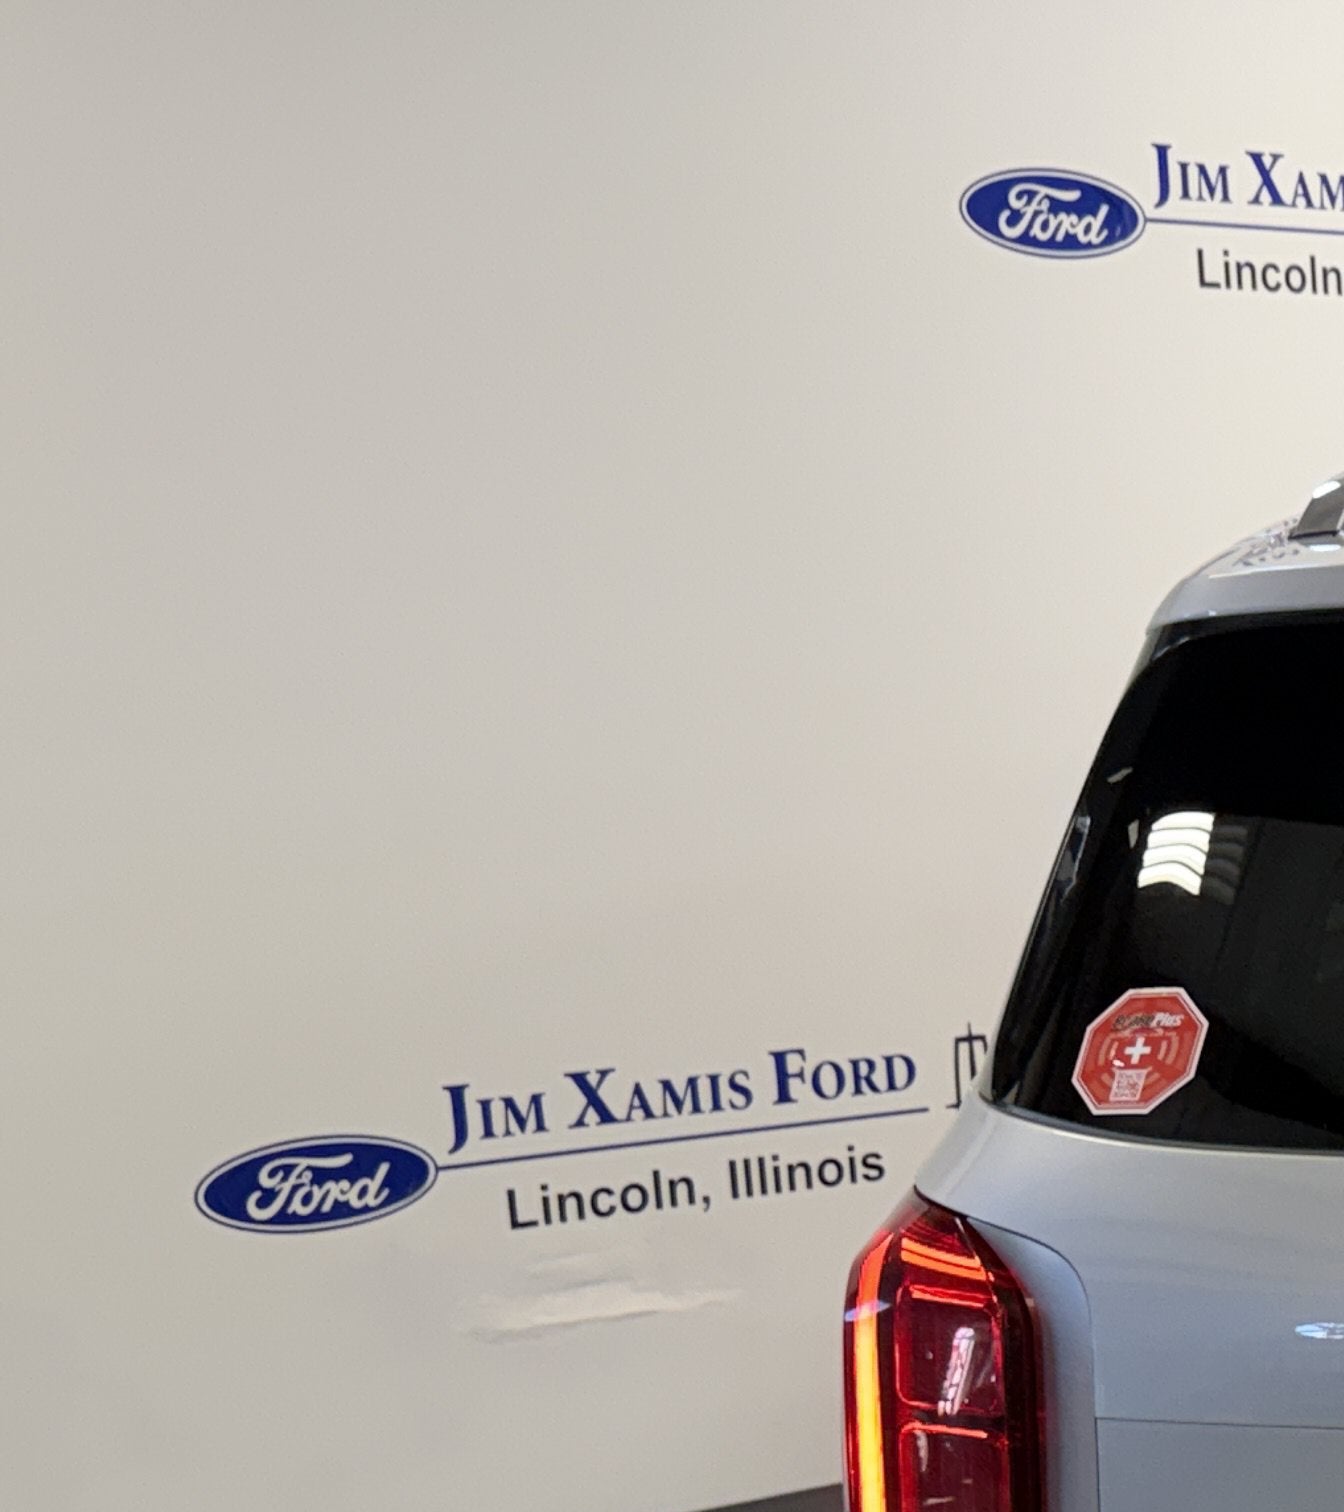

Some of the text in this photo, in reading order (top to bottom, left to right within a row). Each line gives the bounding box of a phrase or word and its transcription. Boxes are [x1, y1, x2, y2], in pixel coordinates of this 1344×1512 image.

[999, 182, 1108, 245] Ford
[245, 1152, 391, 1221] Ford
[507, 1144, 886, 1229] Lincoln, Illinois
